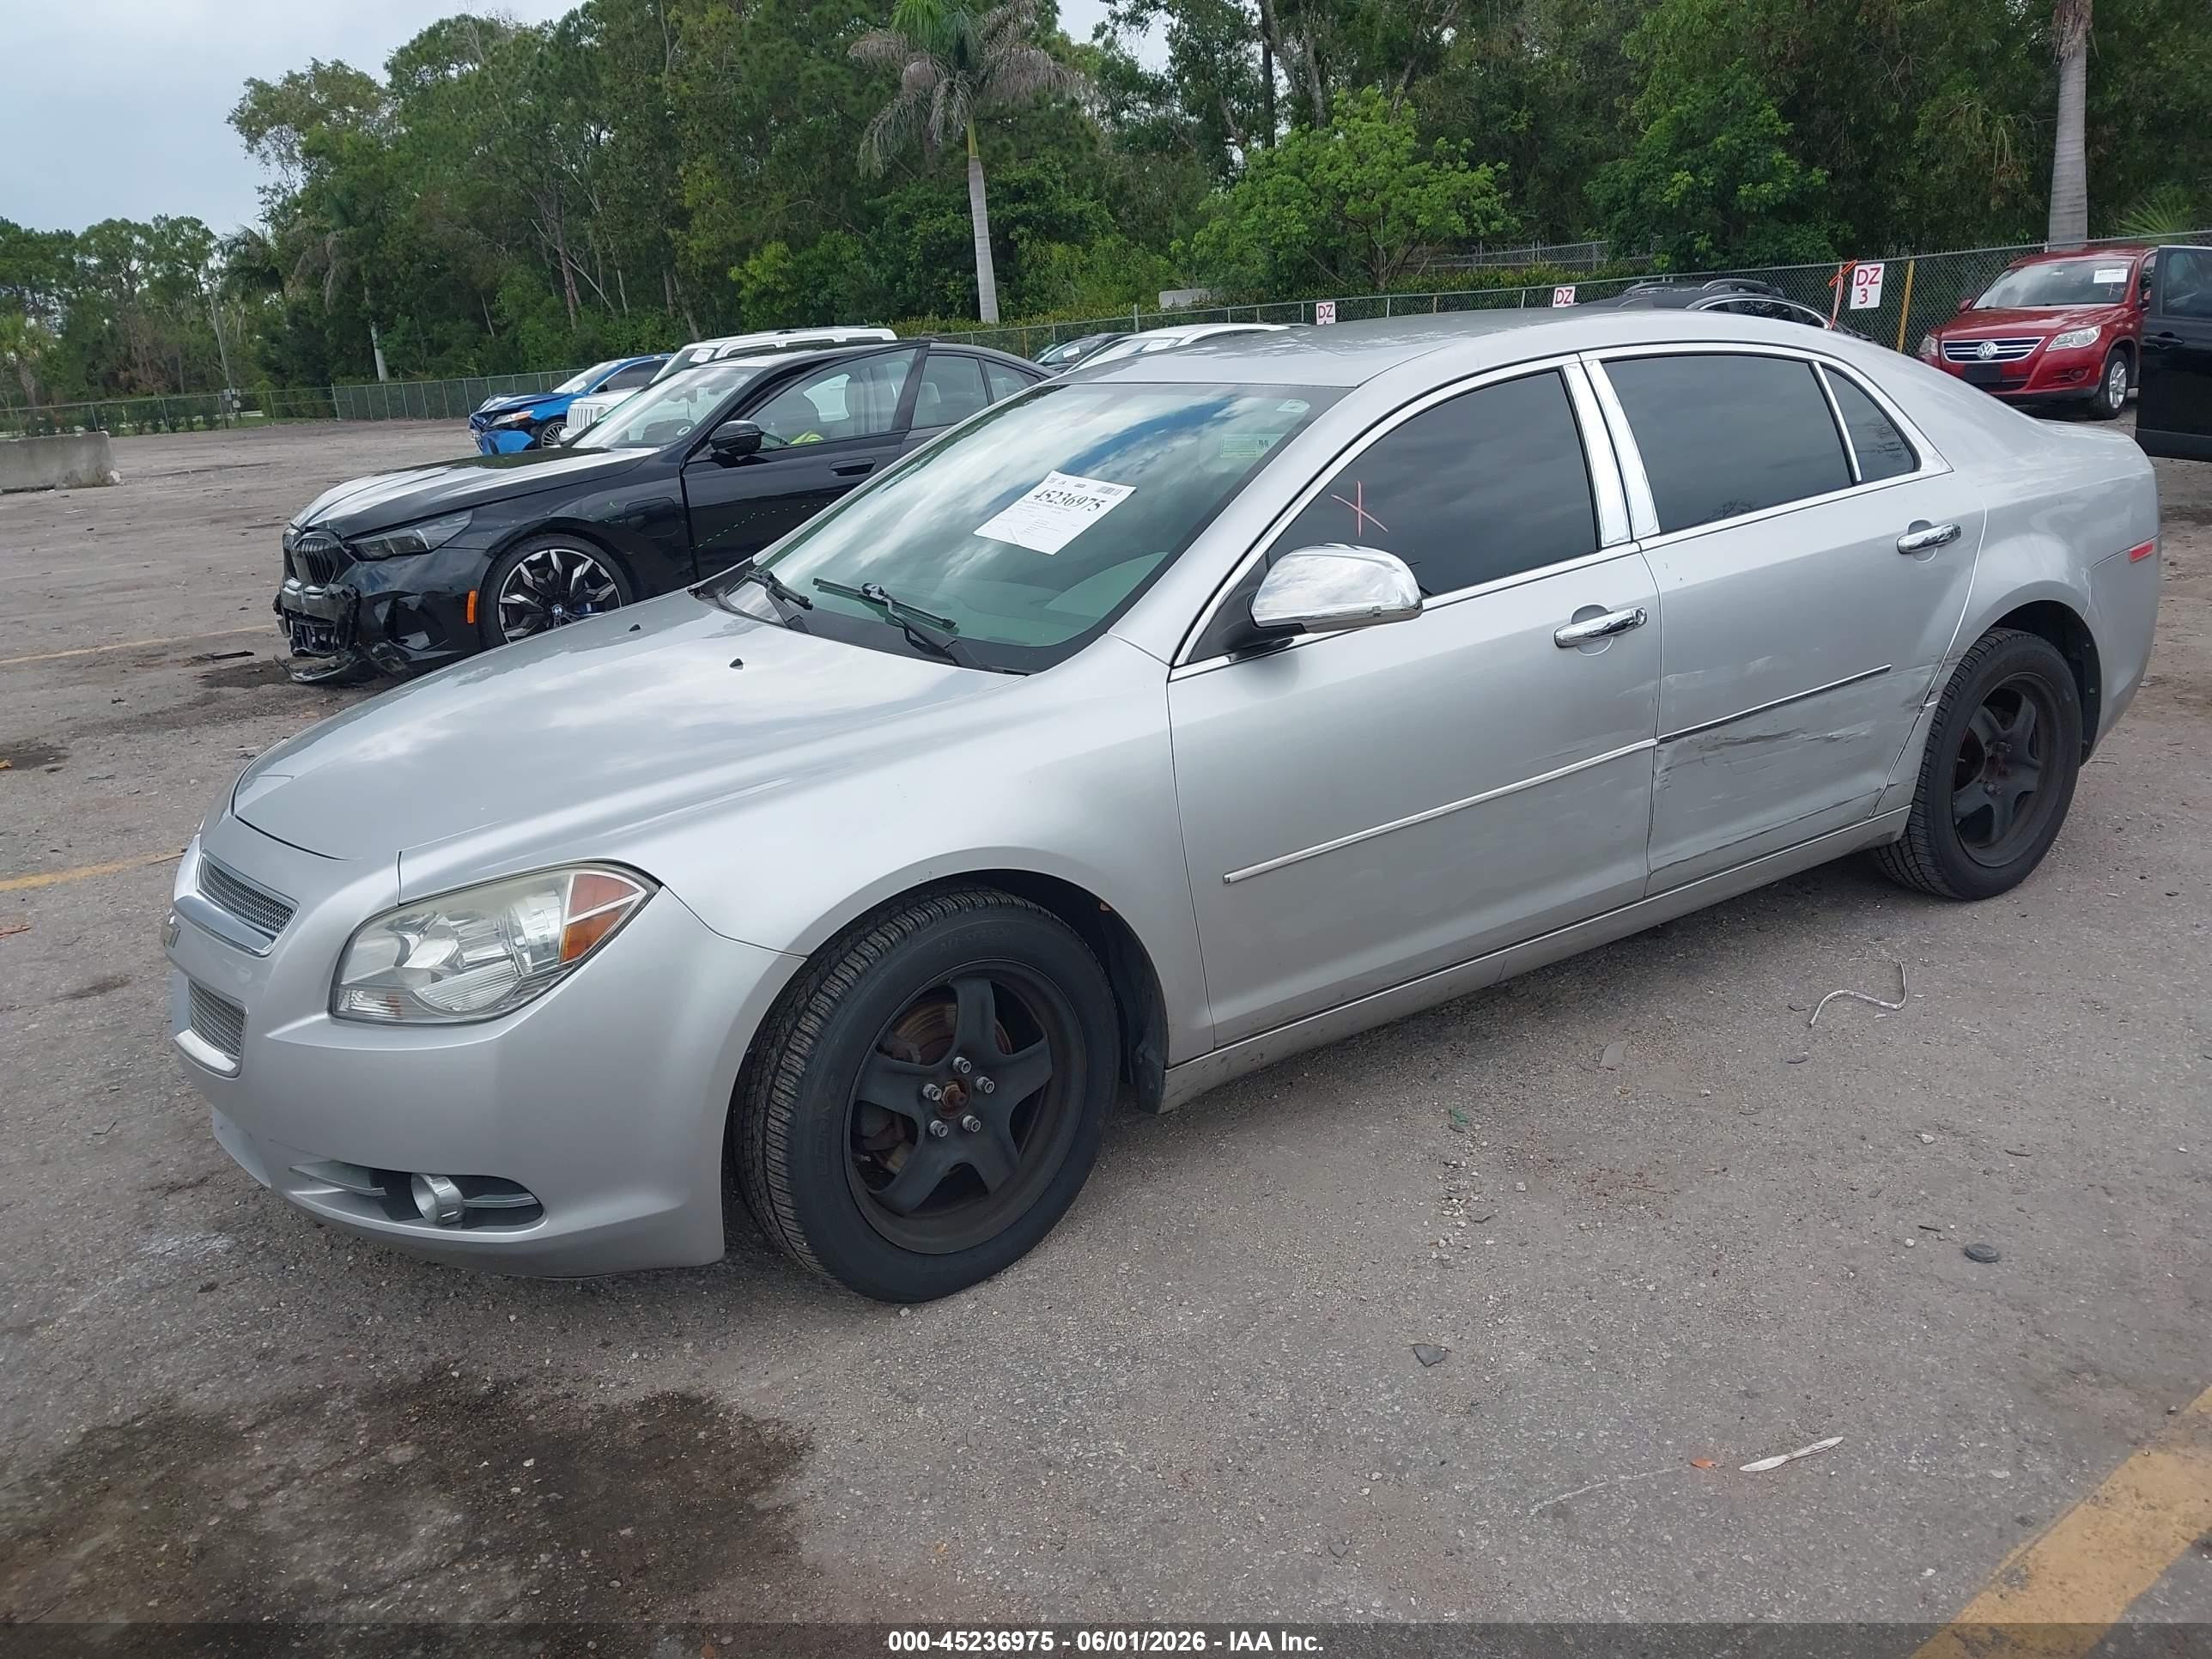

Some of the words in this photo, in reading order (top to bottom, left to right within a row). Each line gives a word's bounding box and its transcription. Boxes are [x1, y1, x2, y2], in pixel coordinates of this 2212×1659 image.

[1856, 267, 1881, 286] DZ
[1555, 289, 1572, 304] DZ
[1858, 289, 1869, 305] 3
[1318, 304, 1334, 319] DZ
[1033, 489, 1108, 512] 45236975
